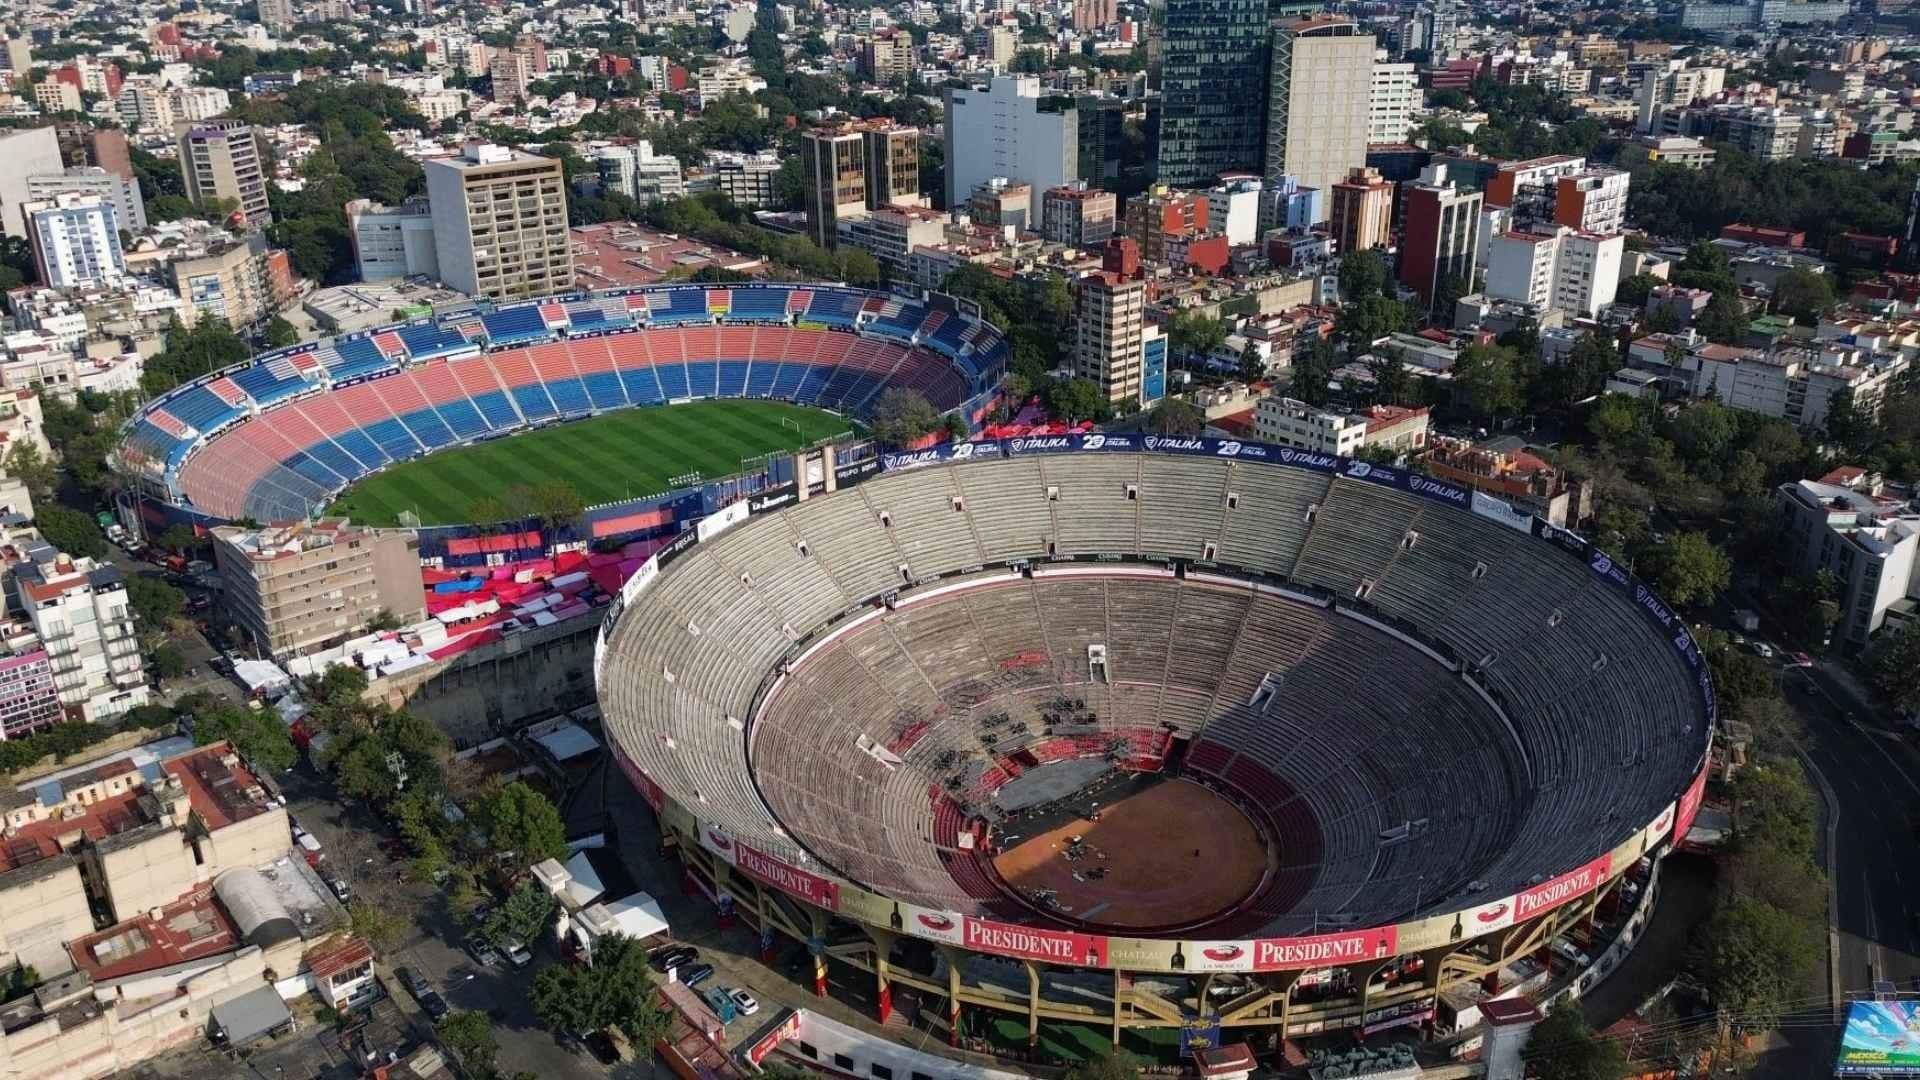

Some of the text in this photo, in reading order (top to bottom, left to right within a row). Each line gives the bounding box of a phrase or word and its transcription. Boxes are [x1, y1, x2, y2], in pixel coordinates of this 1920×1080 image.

[1024, 438, 1069, 450] ITALIKA
[1157, 438, 1203, 450] ITALIKA
[896, 450, 938, 466] ITALIKA
[1292, 453, 1337, 468] ITALIKA
[1421, 482, 1466, 502] ITALIKA
[1644, 595, 1672, 626] ITALIKA
[737, 848, 813, 896] PRESIDENTE
[1519, 870, 1592, 915] PRESIDENTE
[969, 921, 1073, 958] PRESIDENTE
[1260, 938, 1365, 965] PRESIDENTE
